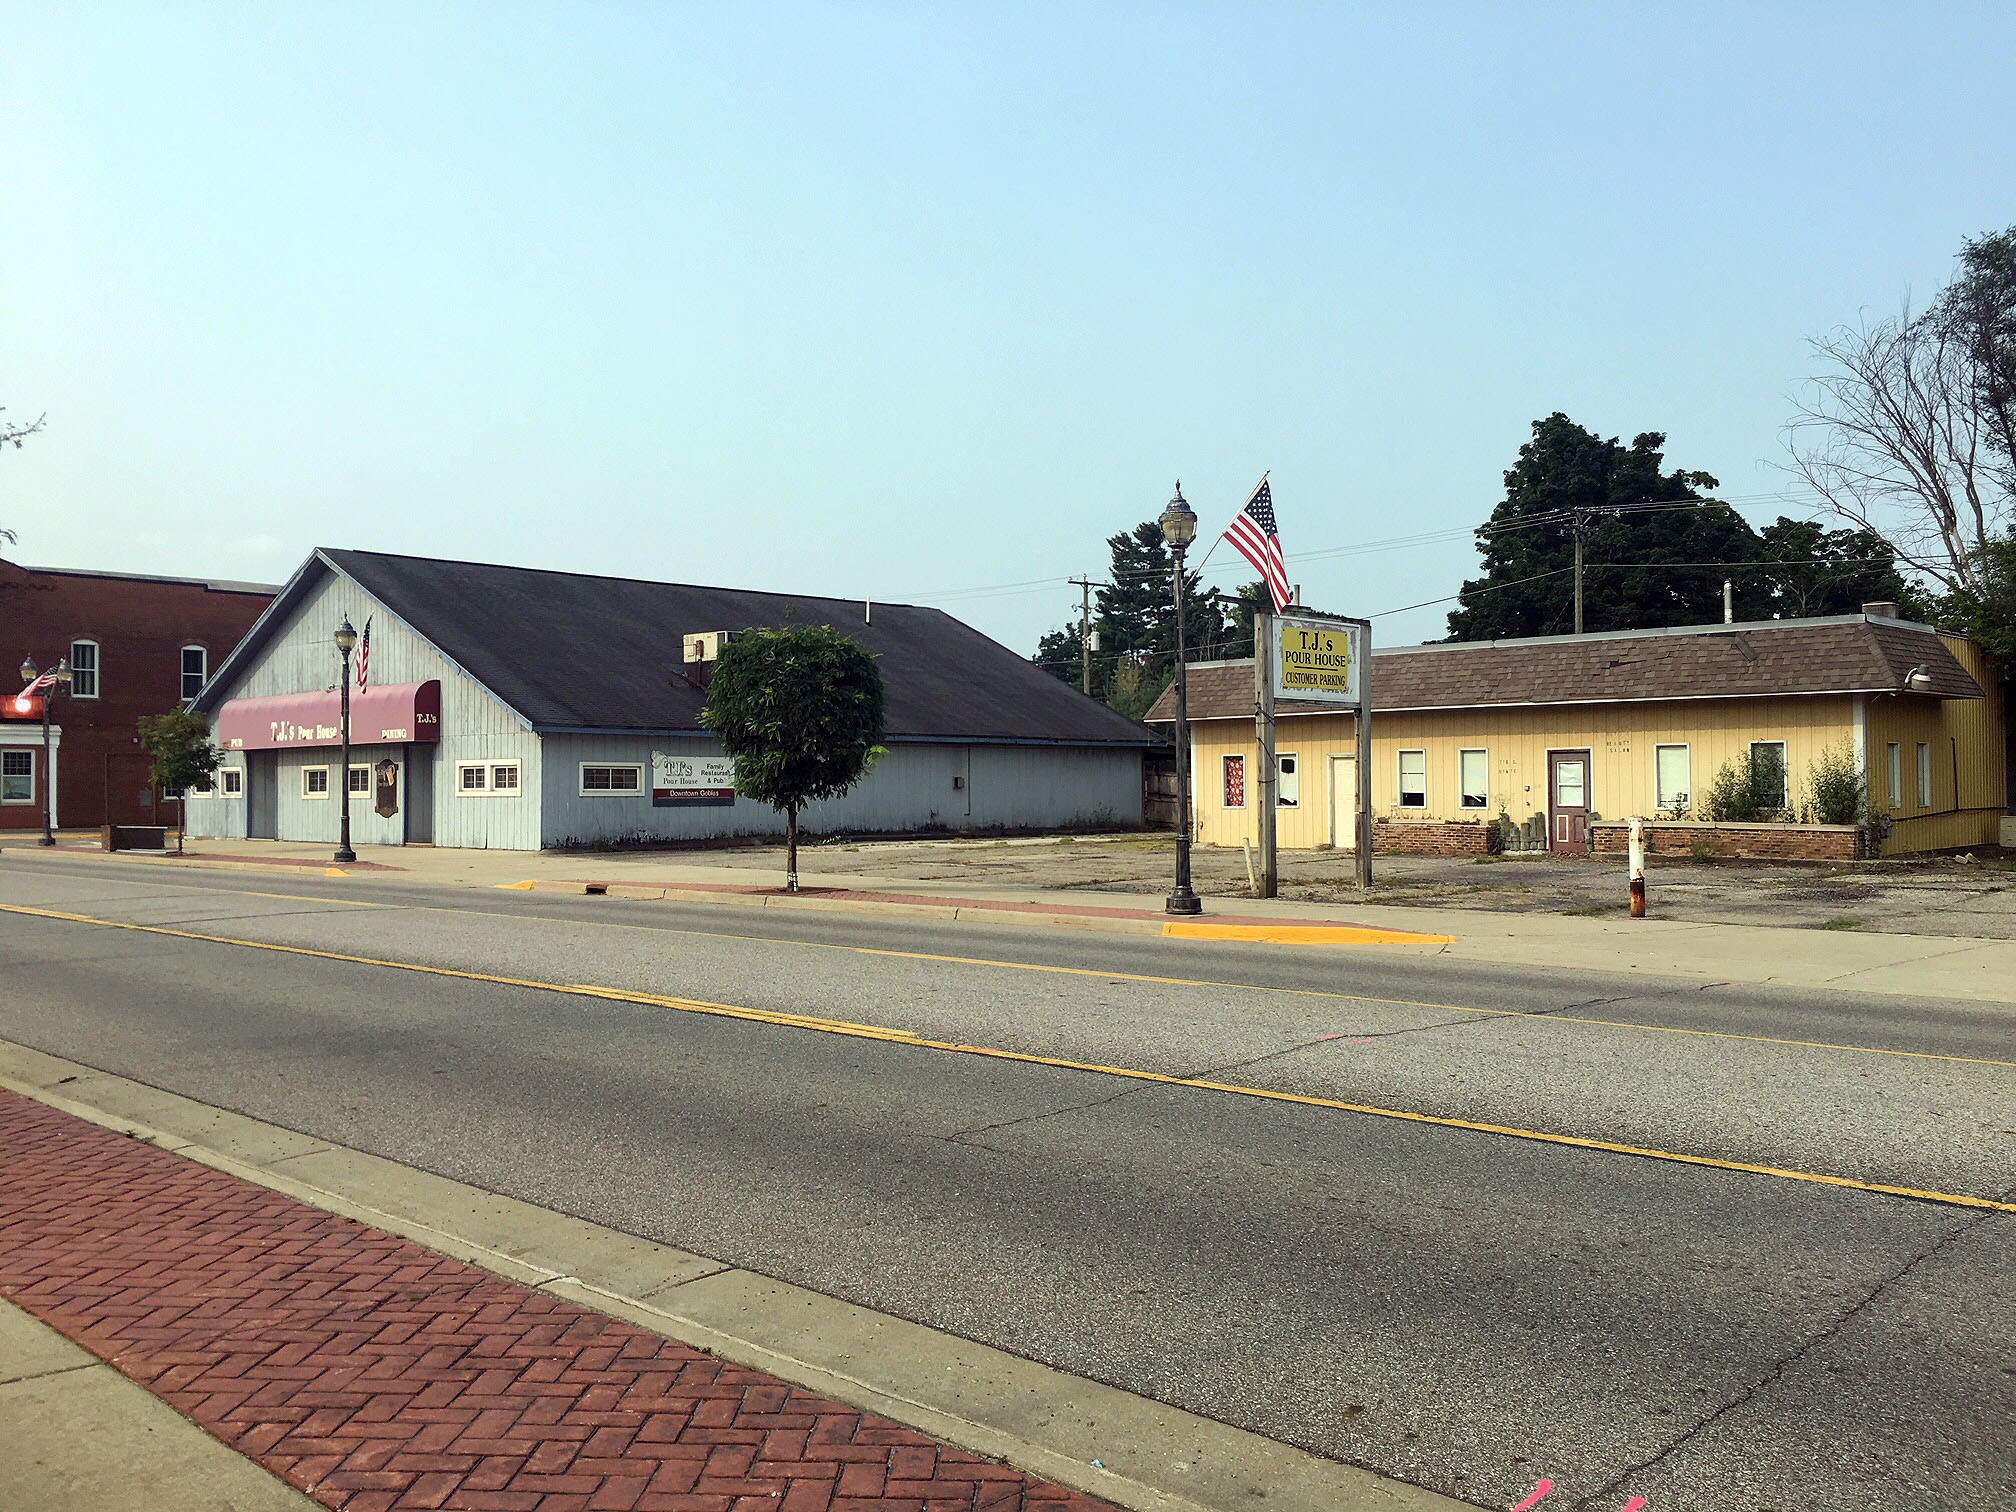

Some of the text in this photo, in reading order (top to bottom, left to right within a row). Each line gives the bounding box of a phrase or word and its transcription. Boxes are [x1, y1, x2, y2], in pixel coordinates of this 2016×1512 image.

[1299, 631, 1333, 651] T.J.'s
[1285, 651, 1346, 667] POUR HOUSE
[1285, 672, 1346, 687] CUSTOMER PARKING
[270, 720, 338, 742] T.J.'s Pour House
[381, 728, 407, 740] DINING
